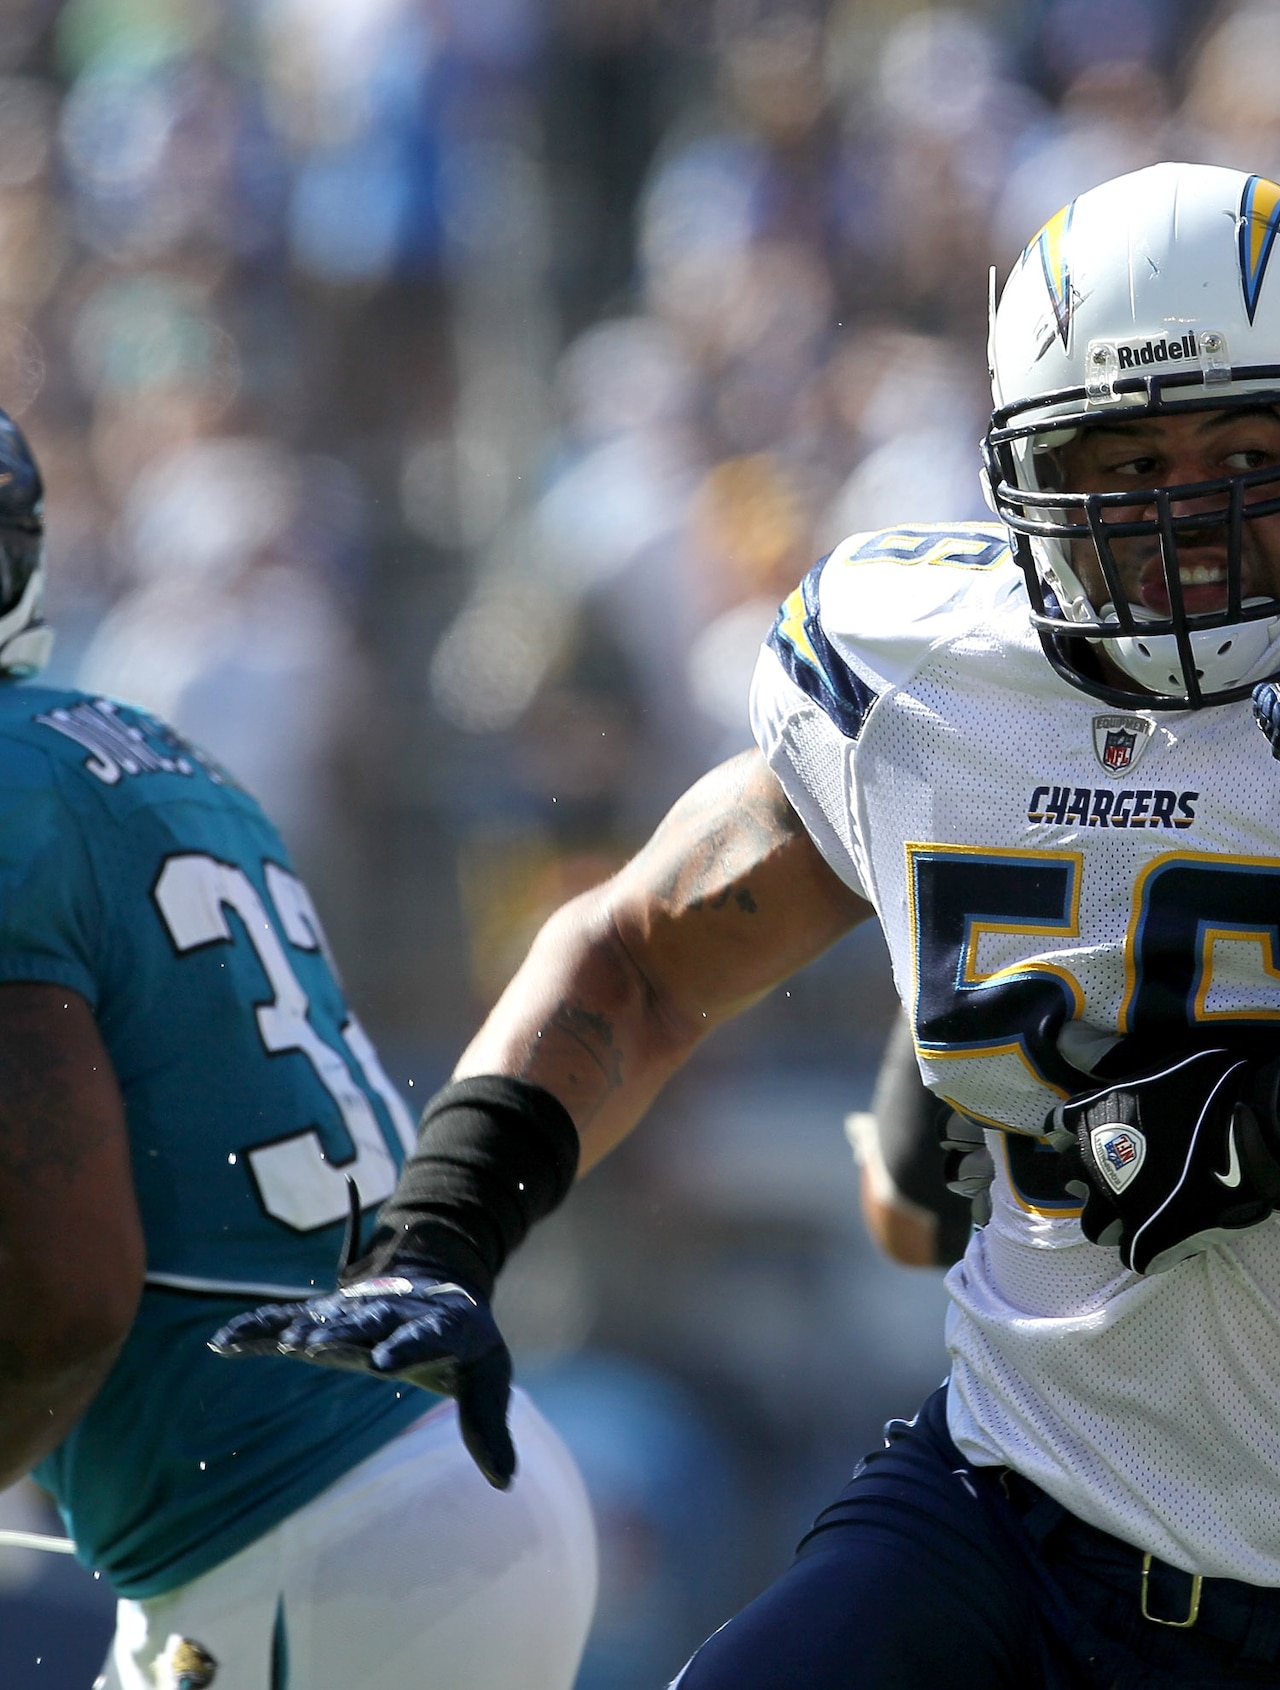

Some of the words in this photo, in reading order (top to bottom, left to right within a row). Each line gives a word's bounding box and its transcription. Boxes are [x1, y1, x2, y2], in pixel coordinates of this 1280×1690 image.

[1117, 334, 1199, 369] Riddell
[1105, 746, 1130, 767] NFL
[1027, 786, 1199, 829] CHARGERS
[1115, 1135, 1135, 1163] NFL
